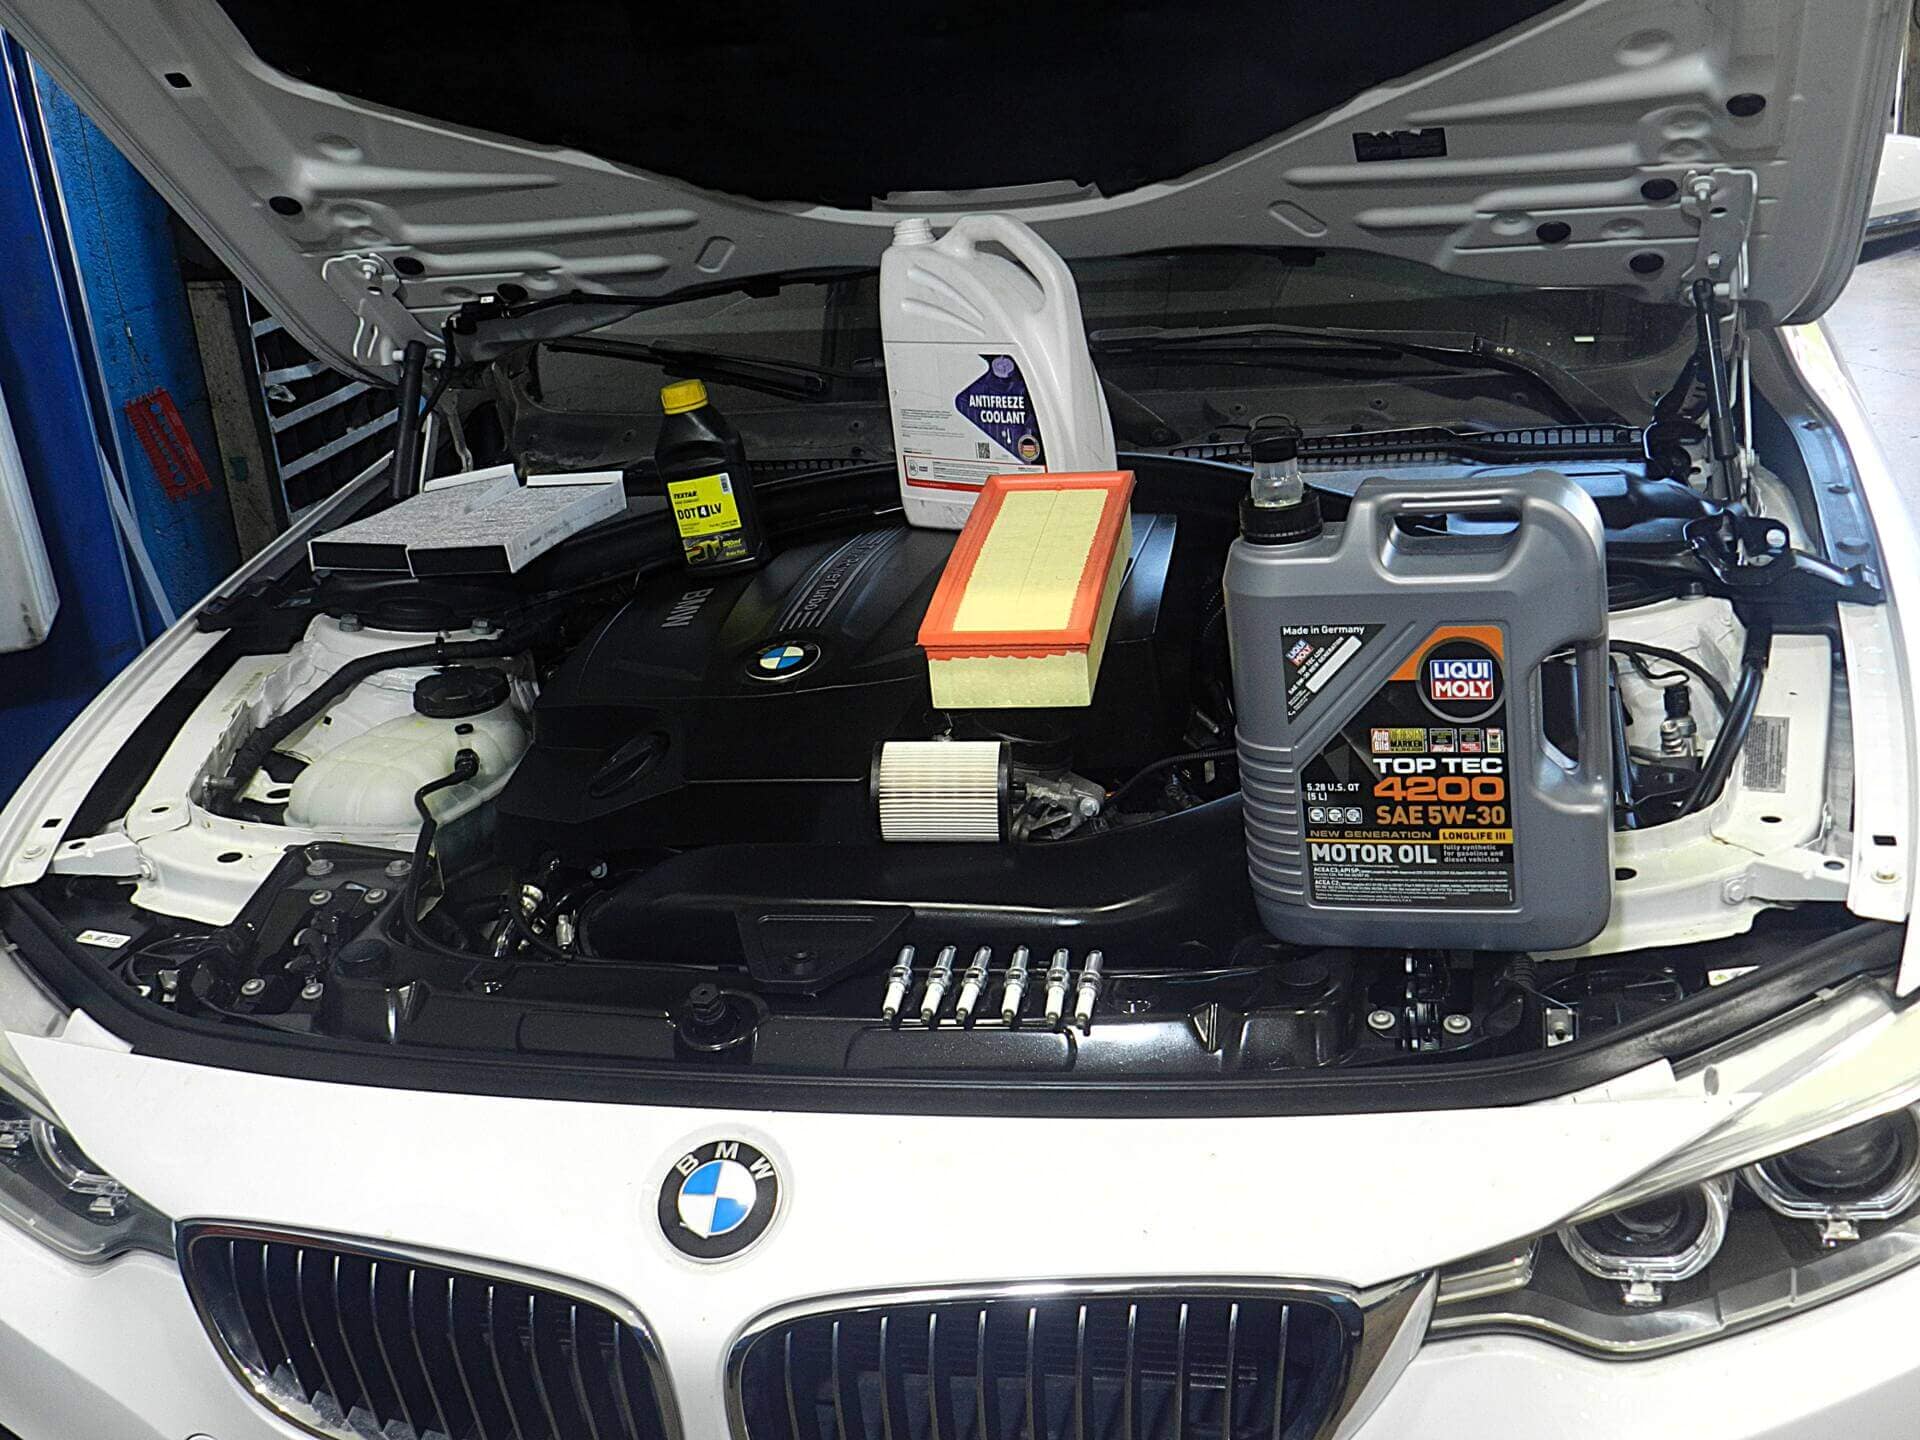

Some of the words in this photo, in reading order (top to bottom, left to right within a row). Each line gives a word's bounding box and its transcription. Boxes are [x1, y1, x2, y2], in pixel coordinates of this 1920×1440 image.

[969, 394, 1025, 409] ANTIFREEZE
[980, 410, 1026, 424] COOLANT
[677, 507, 697, 520] DOT
[661, 588, 714, 627] BMW
[1283, 627, 1309, 636] Made
[1311, 626, 1320, 635] in
[1321, 625, 1365, 636] Germany
[1434, 662, 1489, 679] LIQUI
[1435, 681, 1490, 697] MOLY
[1373, 758, 1436, 773] TOP
[1441, 758, 1503, 773] TEC
[1373, 776, 1505, 801] 4200
[1376, 806, 1424, 825] SAE
[1428, 806, 1506, 824] 5W-30
[1344, 831, 1432, 839] GENERATION
[1442, 831, 1493, 840] LONGLIFE
[1311, 843, 1394, 863] MOTOR
[1398, 845, 1438, 864] OIL
[1456, 850, 1488, 858] gasoline
[675, 1141, 776, 1180] BMW
